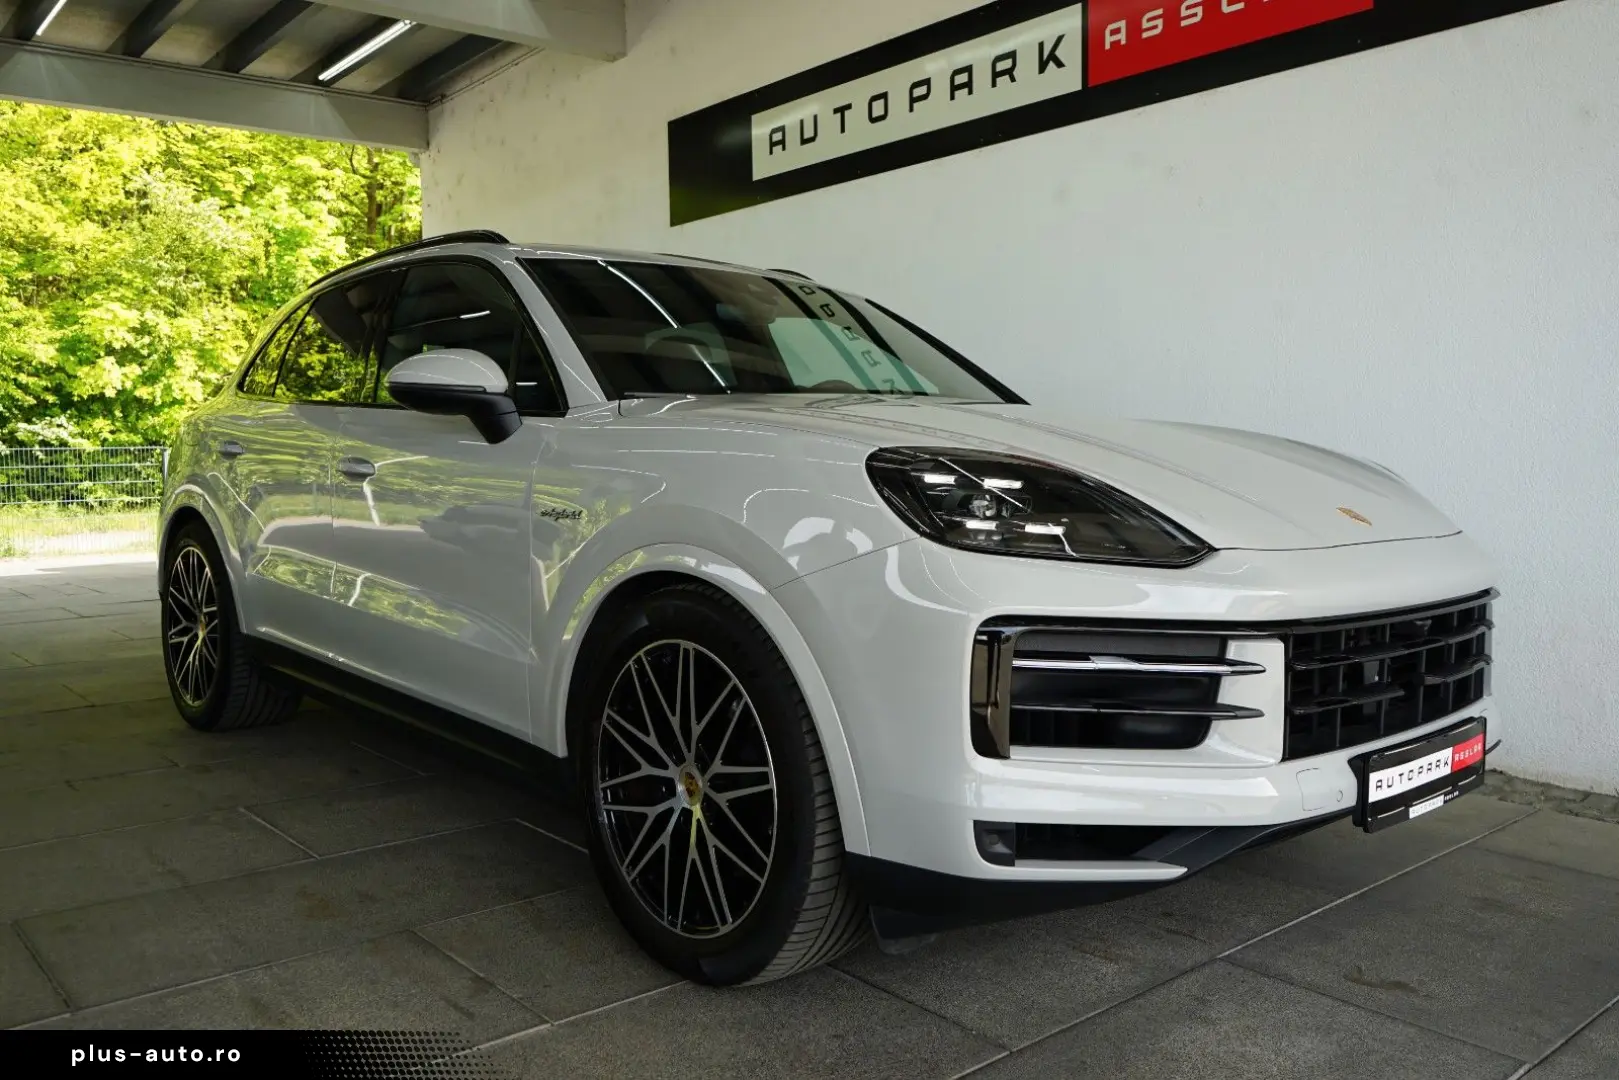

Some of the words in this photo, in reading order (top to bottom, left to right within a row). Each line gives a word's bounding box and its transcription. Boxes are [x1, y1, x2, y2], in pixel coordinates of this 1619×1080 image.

[767, 34, 1067, 155] AUTOPARK
[1104, 0, 1268, 50] ASSL
[1375, 756, 1449, 792] AUTOPARK
